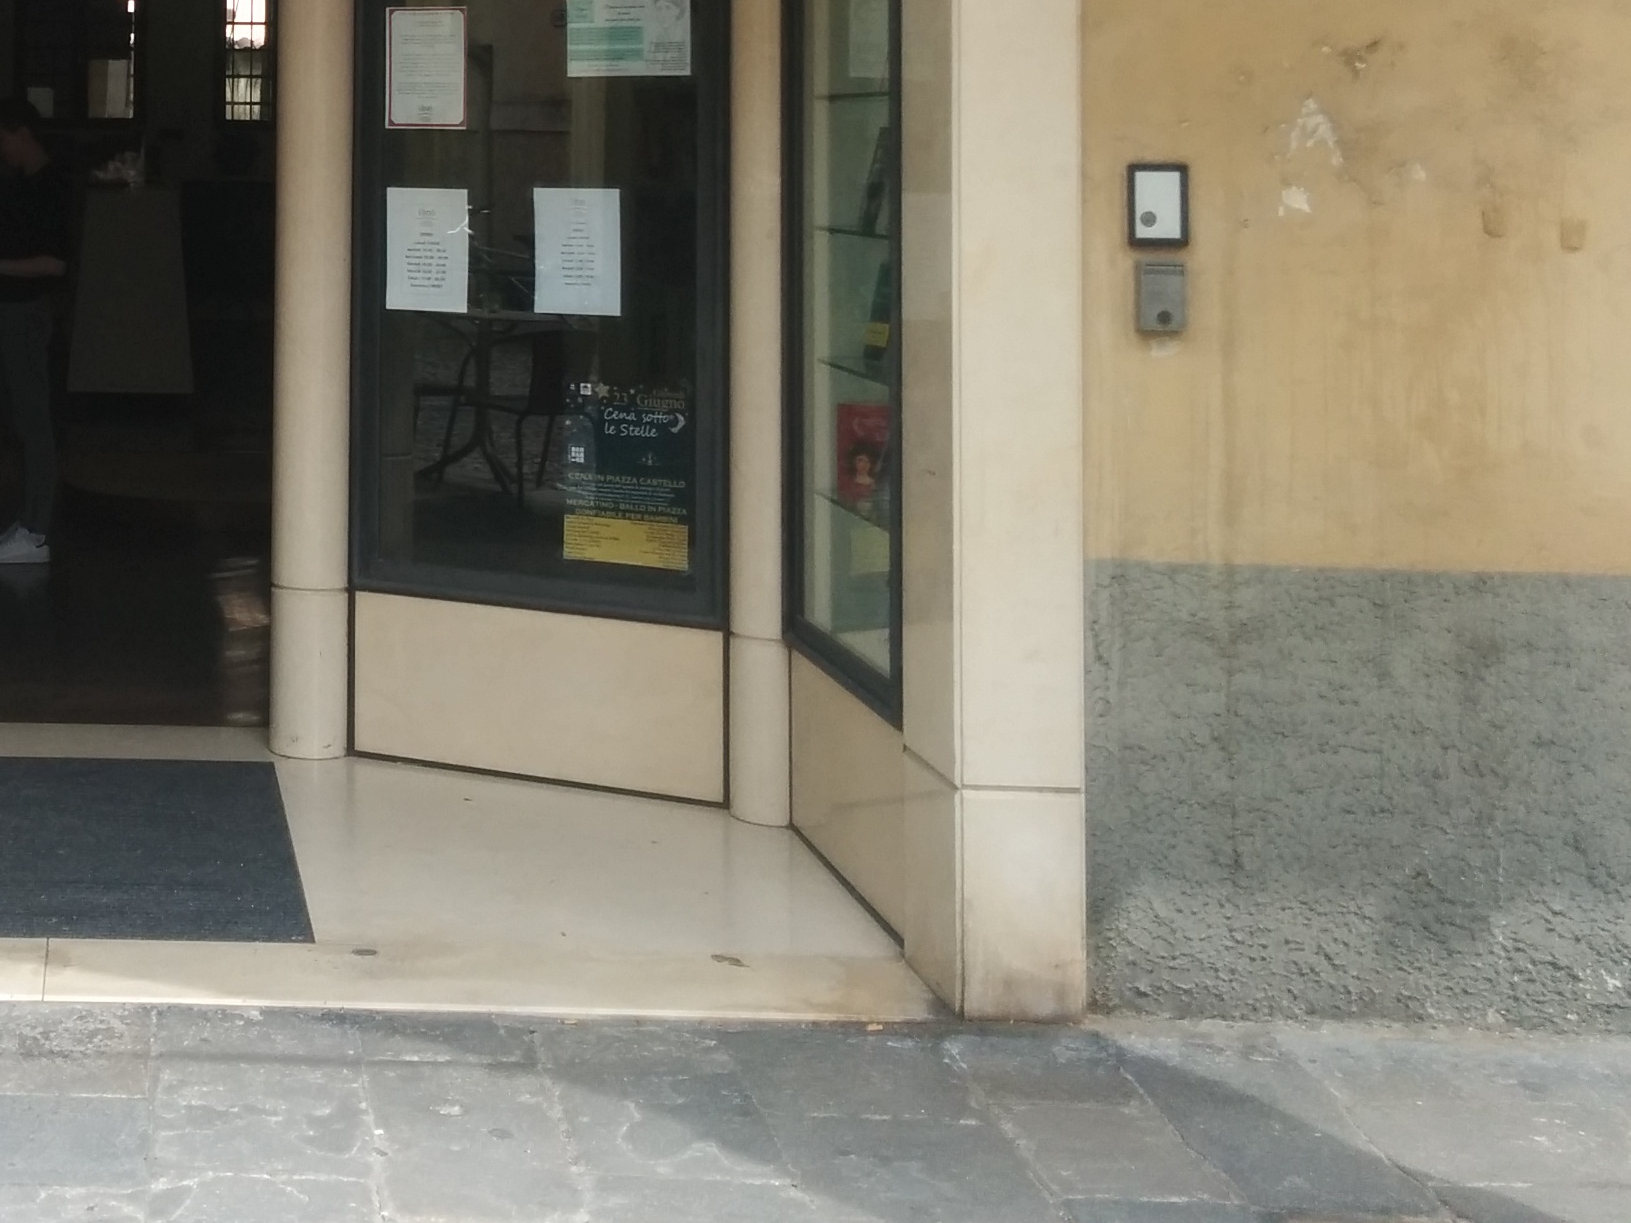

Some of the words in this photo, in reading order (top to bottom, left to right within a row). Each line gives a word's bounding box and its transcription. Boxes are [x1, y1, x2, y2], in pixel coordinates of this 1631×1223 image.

[636, 393, 685, 410] Giugno
[603, 407, 638, 421] Cena
[641, 411, 670, 424] sotto
[603, 422, 617, 435] le
[619, 423, 659, 438] Stelle
[567, 471, 594, 482] CENA
[606, 474, 638, 485] PIAZZA
[639, 477, 687, 489] CASTELLO
